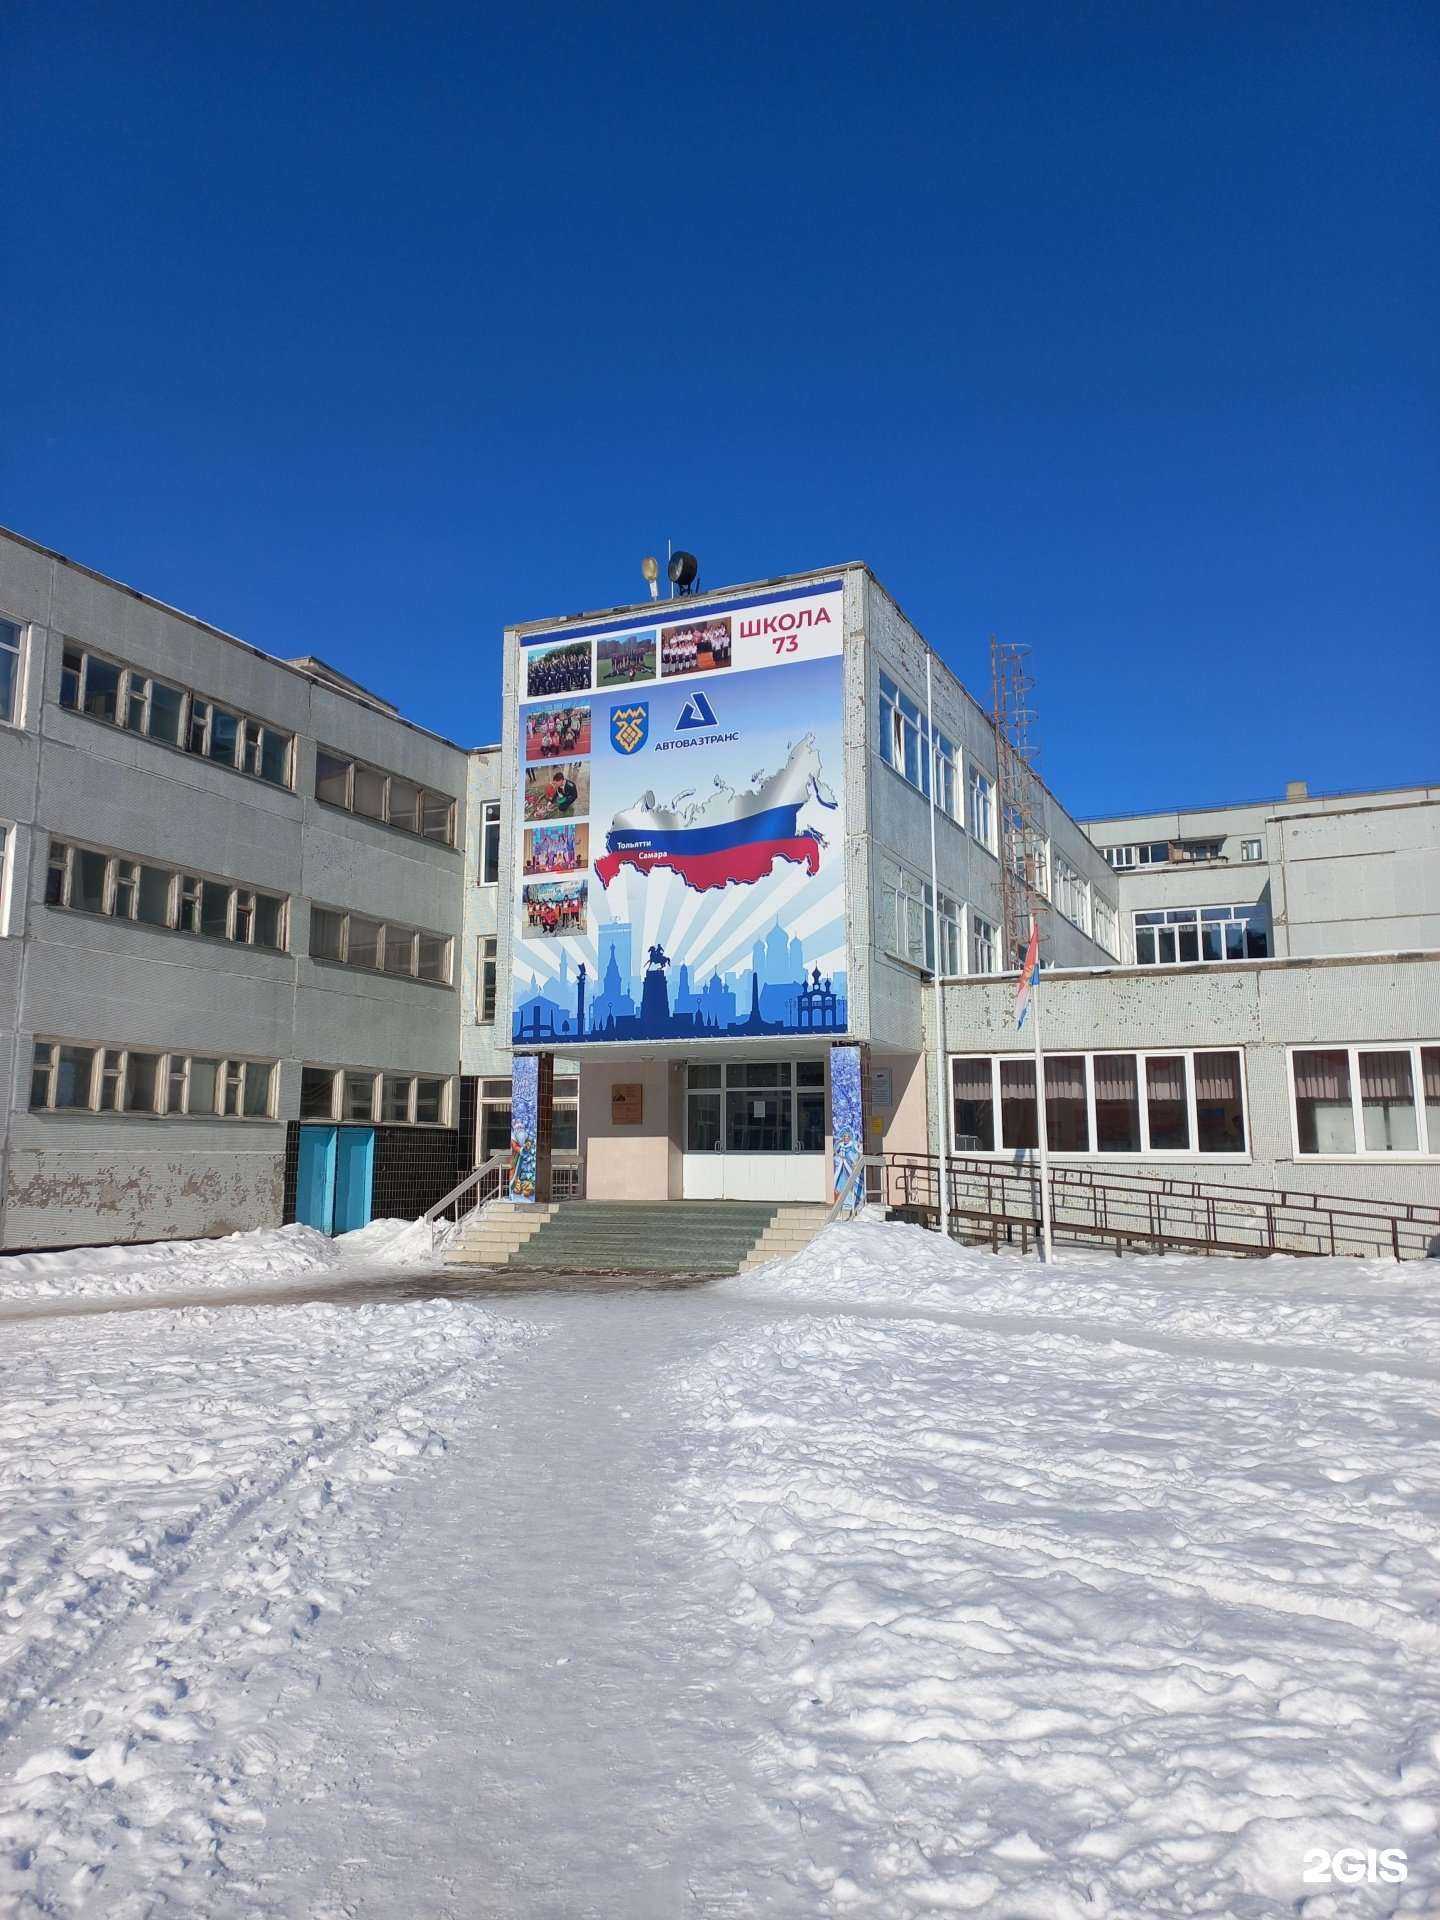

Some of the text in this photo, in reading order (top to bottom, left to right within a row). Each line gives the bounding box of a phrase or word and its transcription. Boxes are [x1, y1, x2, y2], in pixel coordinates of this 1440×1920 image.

[740, 607, 832, 638] ШКОЛА
[772, 634, 799, 655] 73
[655, 732, 740, 752] АВТОВАЗТРАНС
[617, 840, 652, 849] Тольятти
[638, 851, 668, 860] Самара
